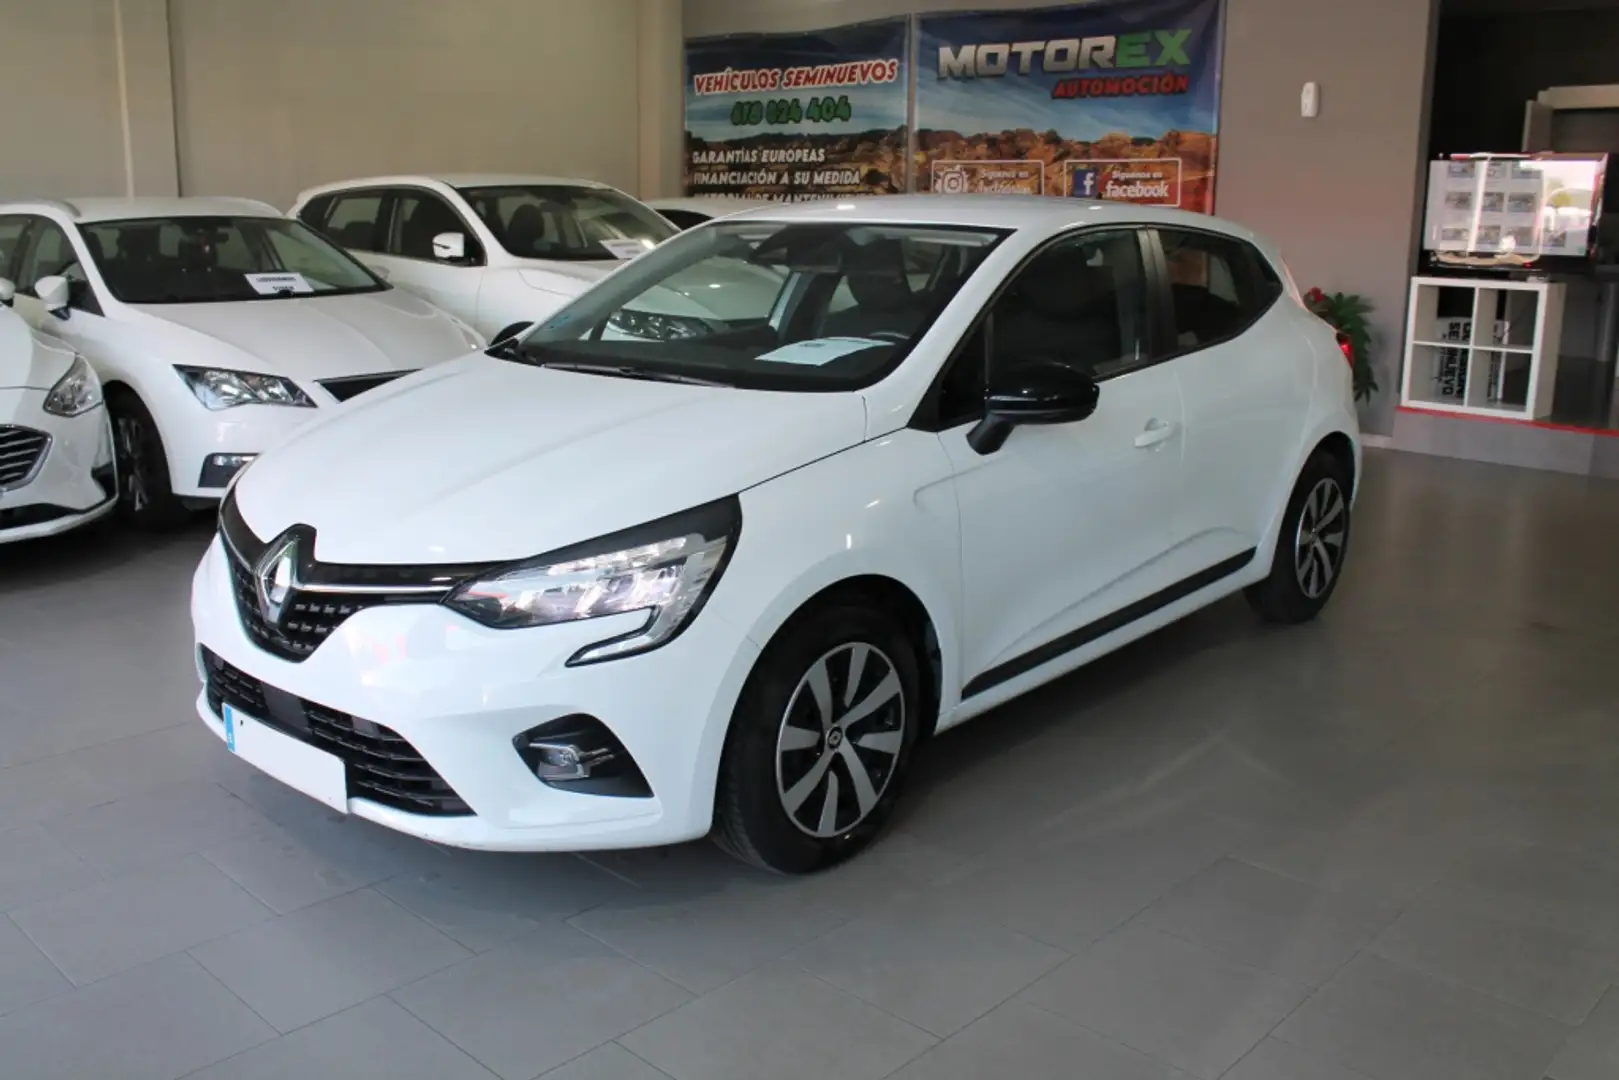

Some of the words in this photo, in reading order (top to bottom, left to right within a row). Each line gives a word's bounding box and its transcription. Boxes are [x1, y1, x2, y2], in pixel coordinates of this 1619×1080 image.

[938, 28, 1192, 80] MOTOREX
[694, 67, 780, 95] VEHÍCULOS
[782, 59, 898, 89] SEMINUEVOS
[1052, 72, 1189, 99] AUTOMOCIÓN
[806, 95, 851, 122] 404
[692, 148, 757, 164] GARANTÍAS
[760, 148, 825, 163] EUROPEAS
[693, 168, 776, 185] FINANCIACIÓN
[779, 171, 789, 185] A
[793, 170, 810, 185] SU
[812, 168, 860, 185] MEDIDA
[1105, 179, 1169, 198] facebook
